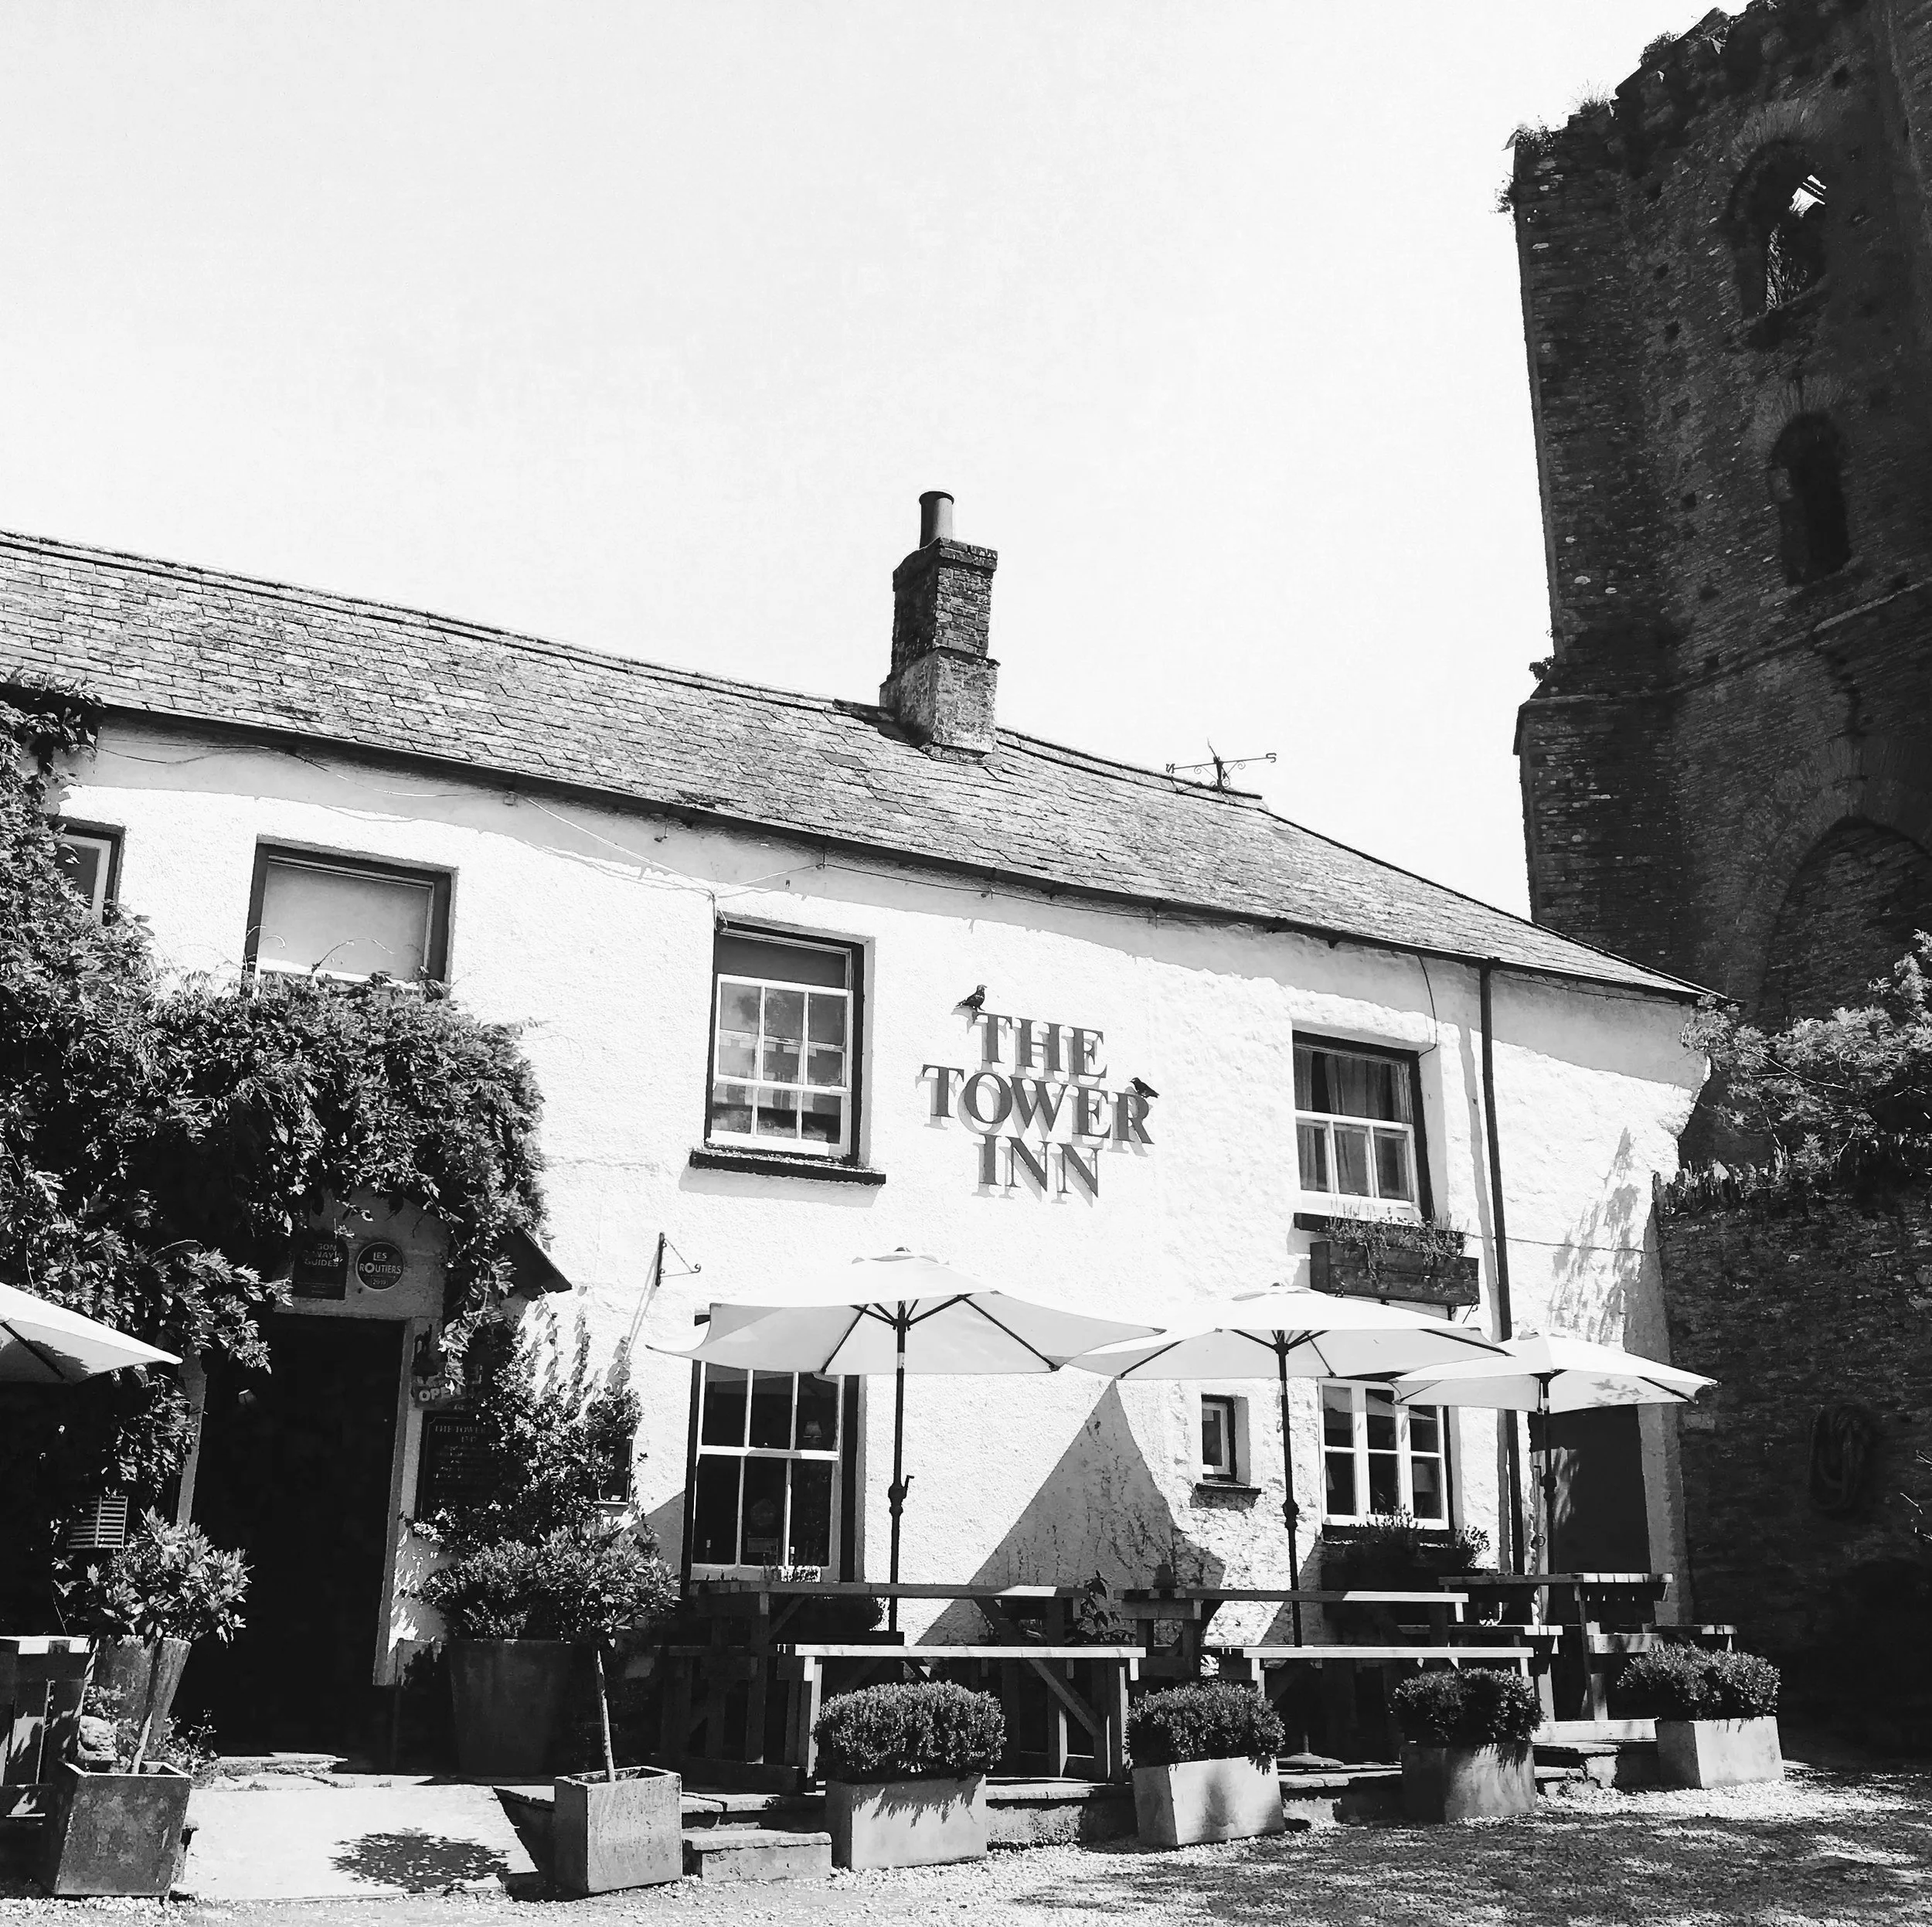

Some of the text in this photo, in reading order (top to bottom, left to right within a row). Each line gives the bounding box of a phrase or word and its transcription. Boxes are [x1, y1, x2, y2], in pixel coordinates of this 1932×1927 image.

[971, 1011, 1108, 1079] THE
[922, 1064, 1155, 1145] TOWER
[978, 1132, 1103, 1199] INN
[304, 1258, 339, 1268] GUIDES
[359, 1262, 402, 1275] ROUTIERS
[373, 1251, 388, 1261] LES
